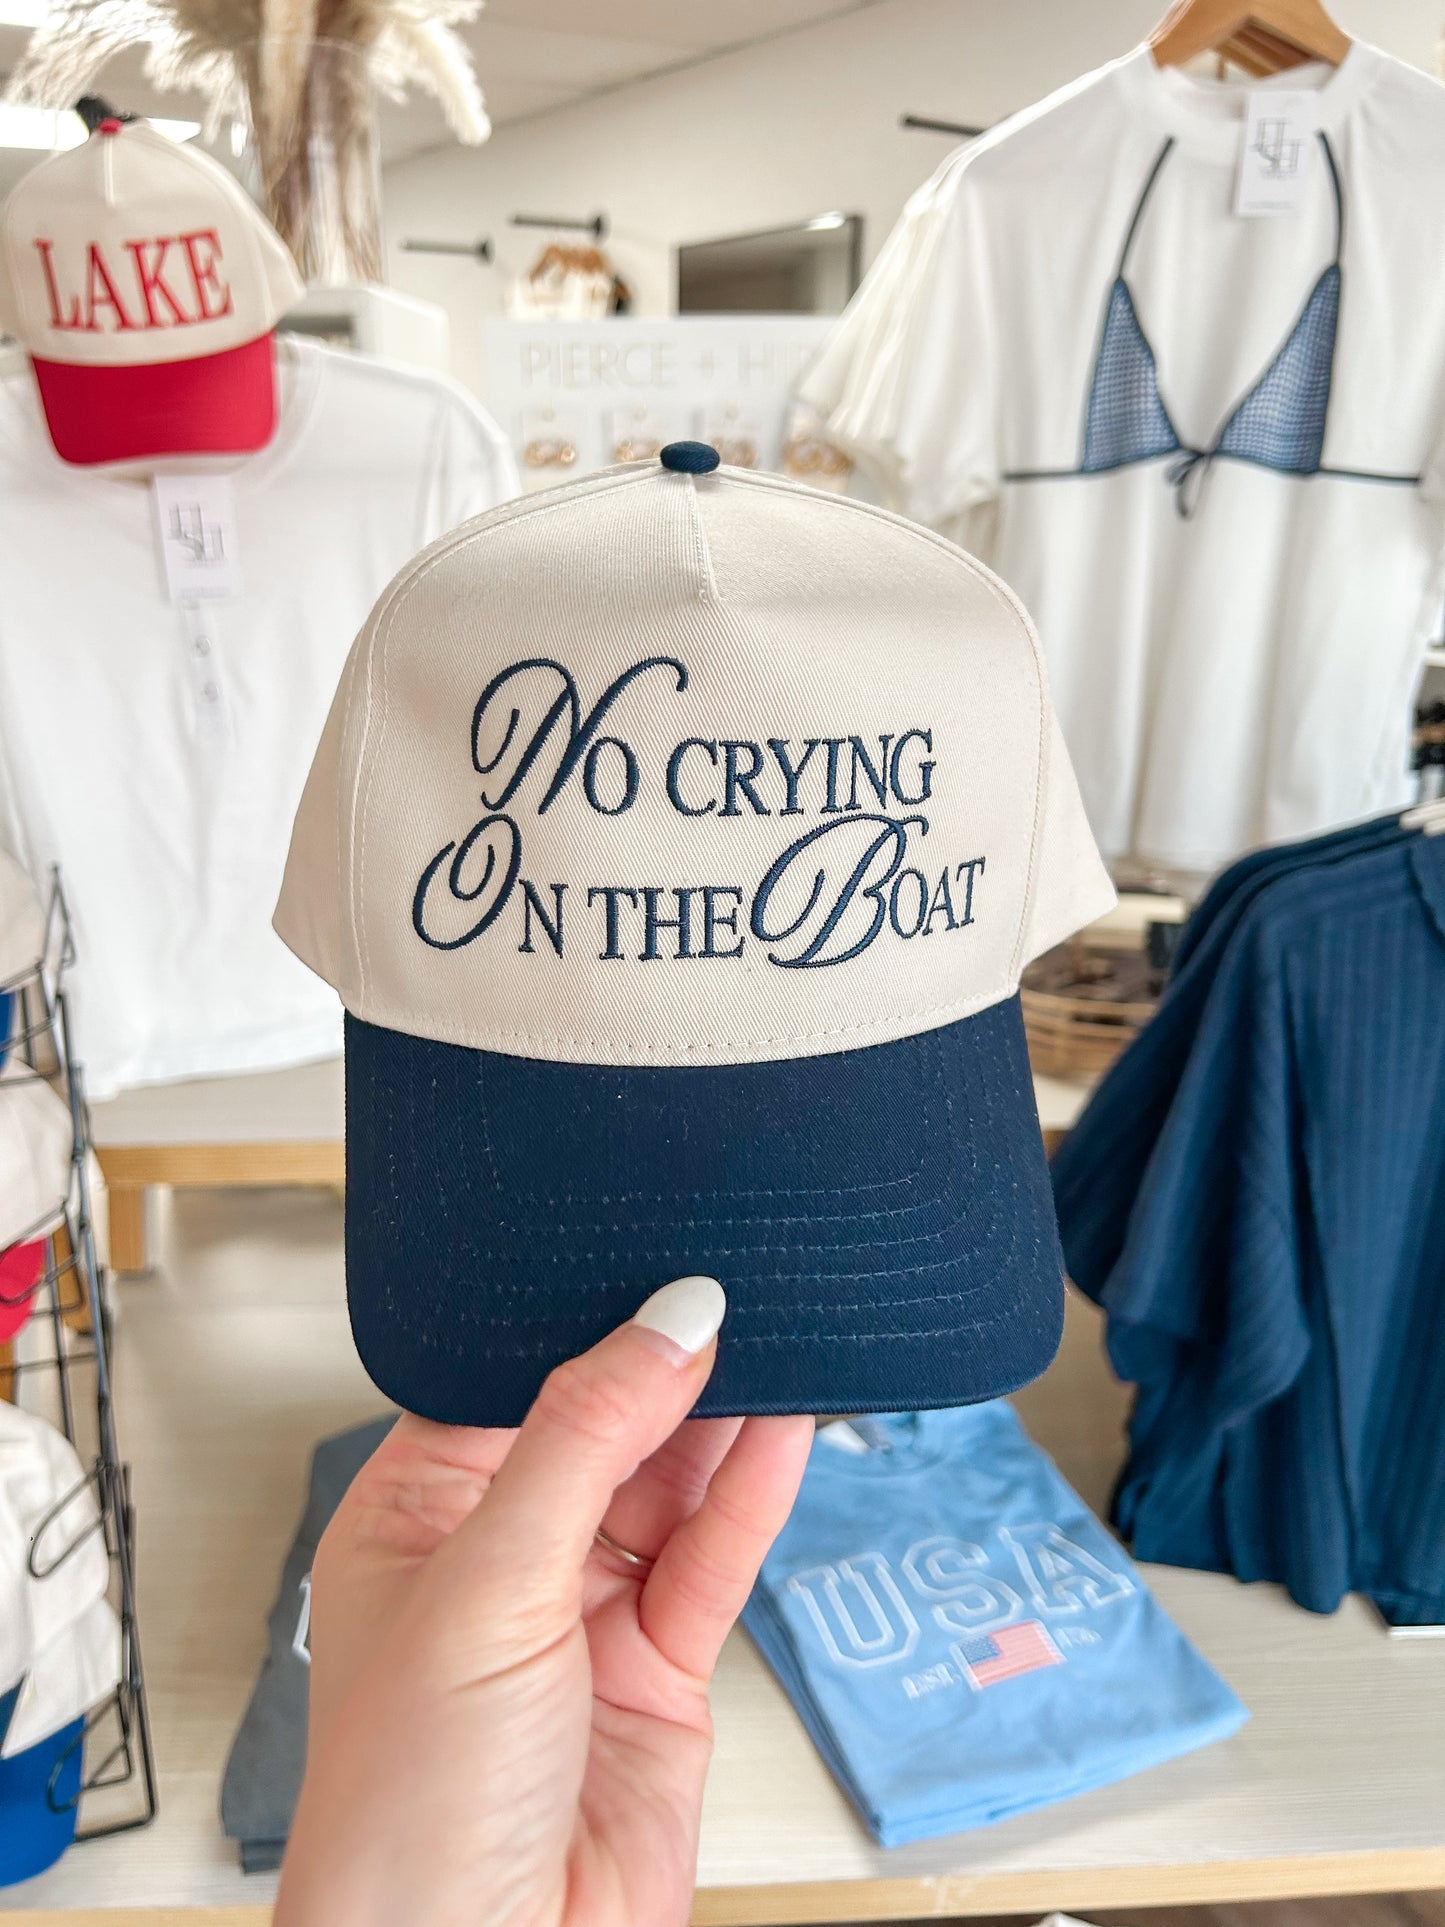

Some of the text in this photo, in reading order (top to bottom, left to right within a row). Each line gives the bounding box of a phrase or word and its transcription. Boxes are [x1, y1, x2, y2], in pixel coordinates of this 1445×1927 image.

[33, 228, 234, 334] LAKE
[519, 341, 674, 388] PIERCE
[666, 728, 936, 818] CRYING
[588, 886, 745, 962] THE
[786, 1522, 1138, 1668] USA
